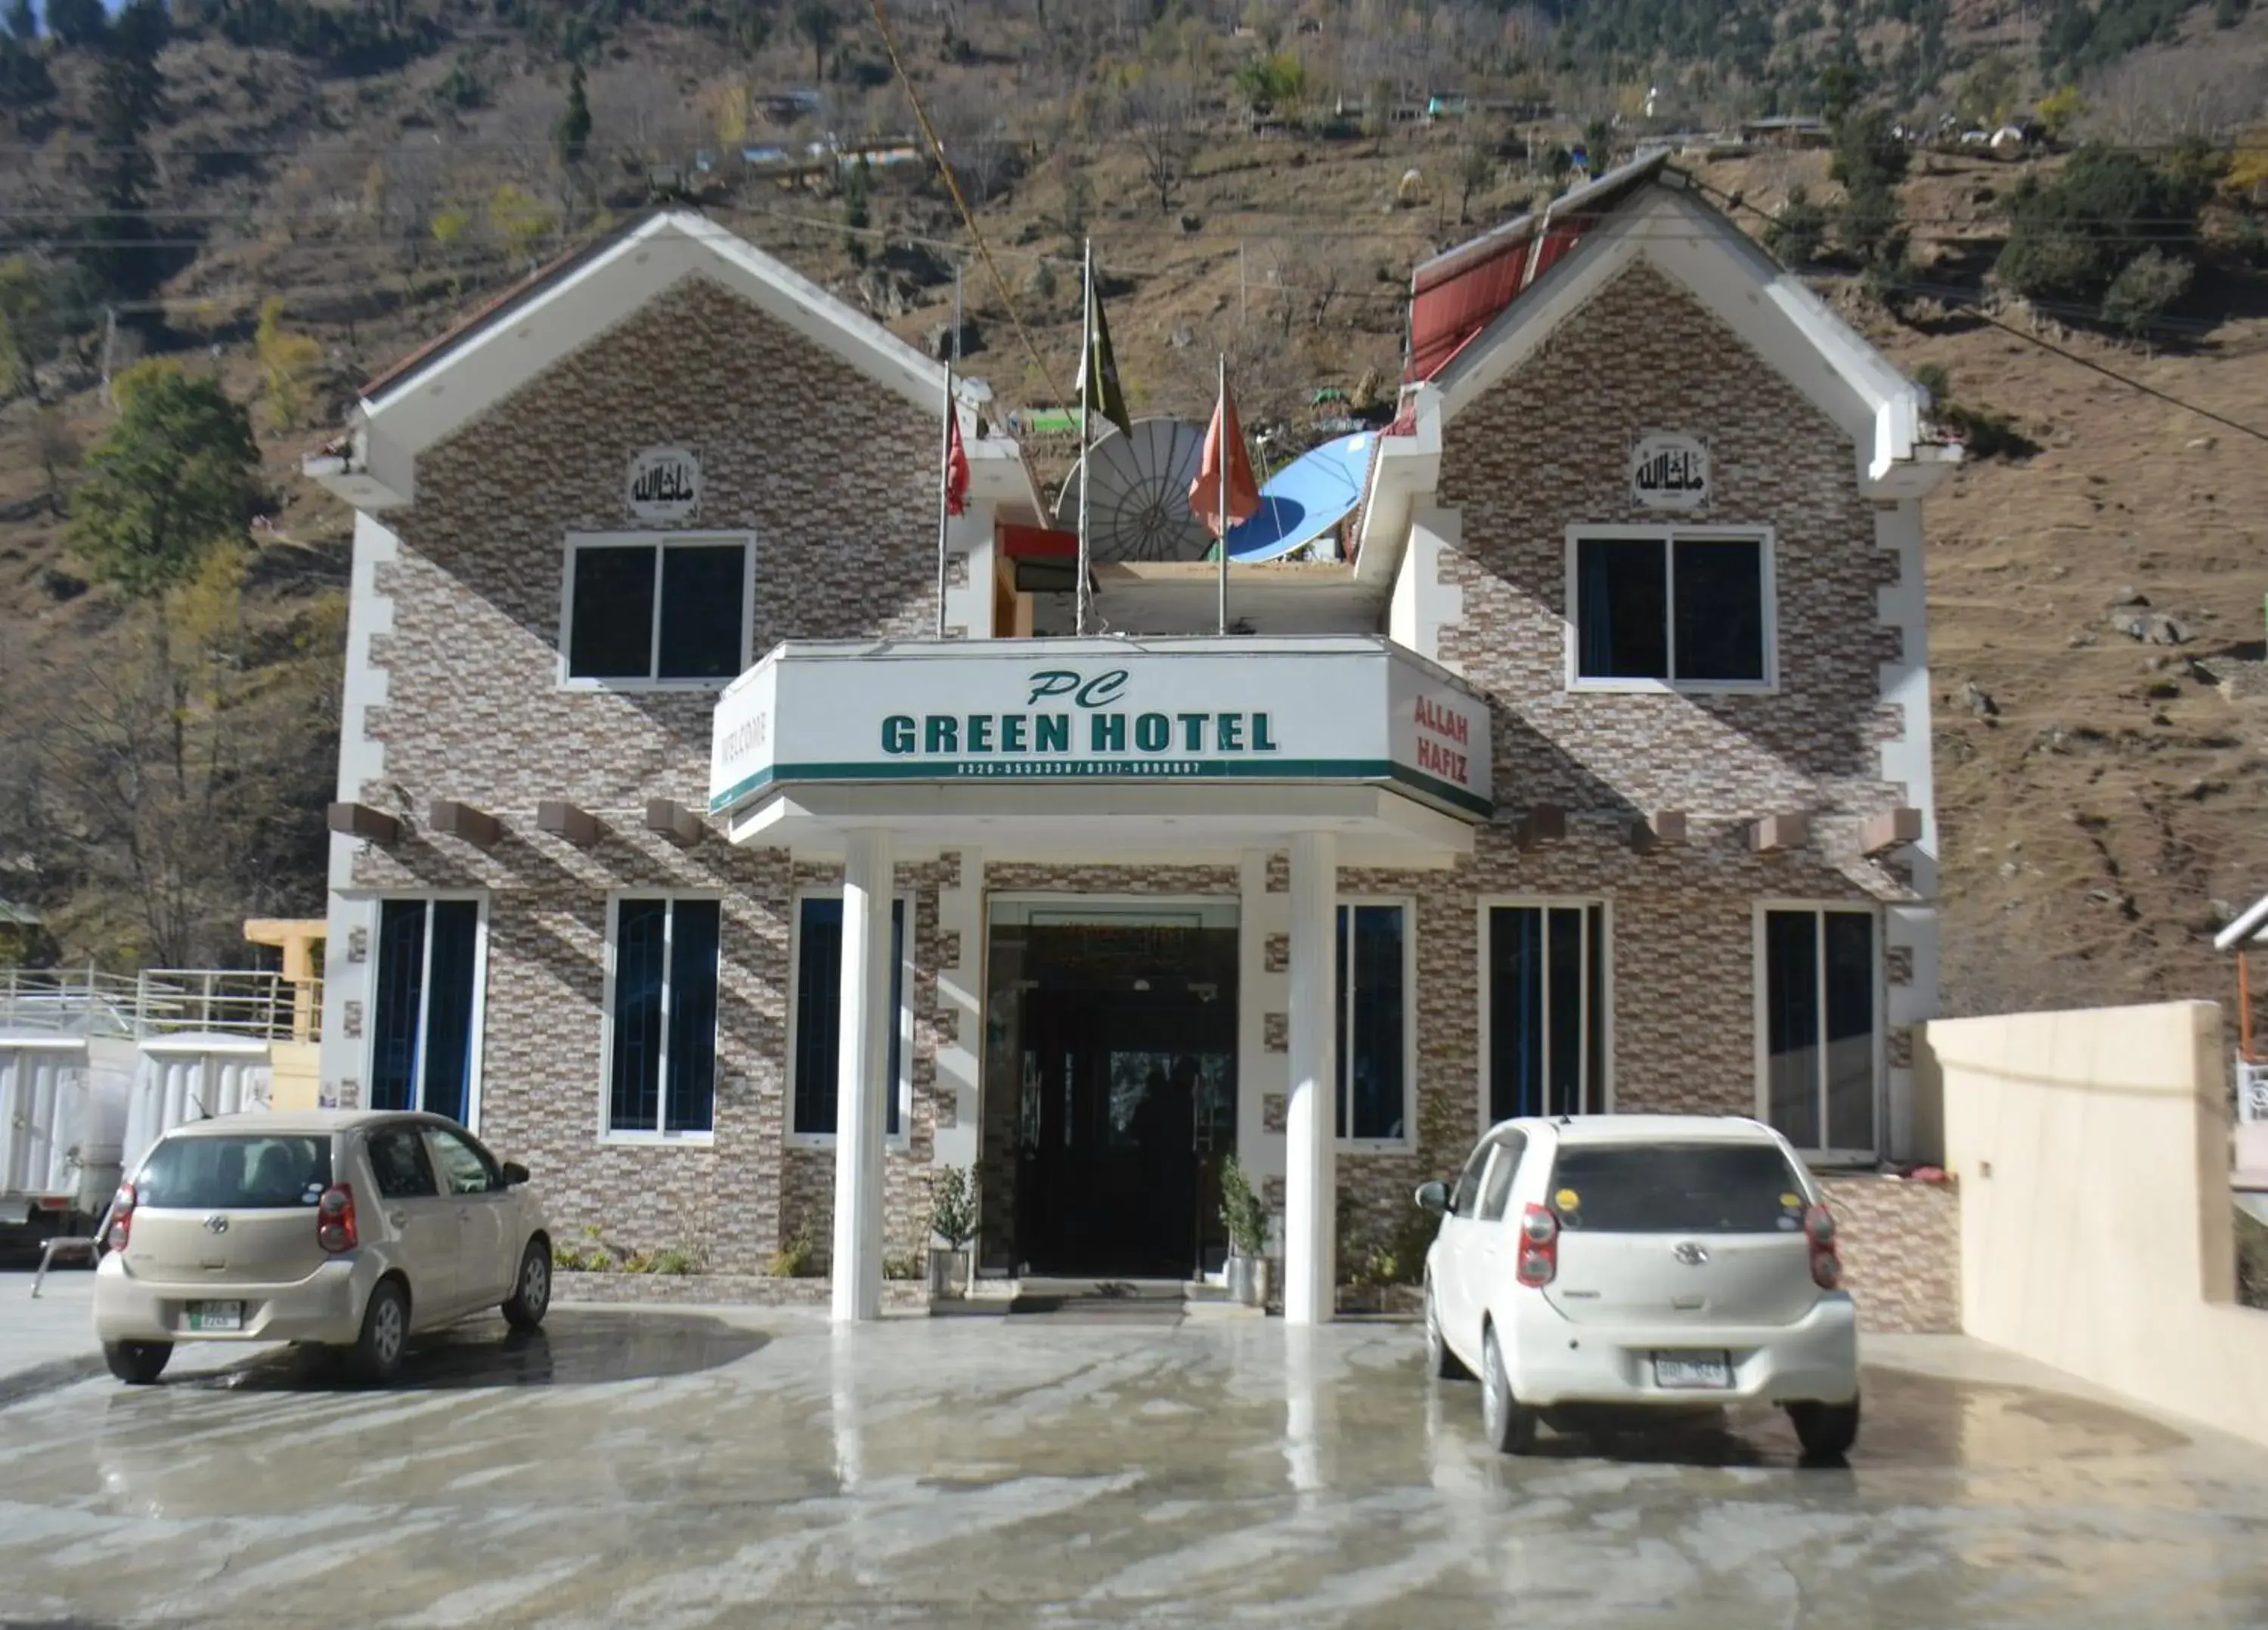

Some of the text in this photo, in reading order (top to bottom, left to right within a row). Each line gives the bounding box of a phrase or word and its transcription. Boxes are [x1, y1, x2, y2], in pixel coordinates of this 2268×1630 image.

[1028, 670, 1129, 708] PC
[881, 713, 1277, 754] GREEN HOTEL
[1415, 695, 1467, 745] ALLAH
[1418, 736, 1467, 784] HAFIZ
